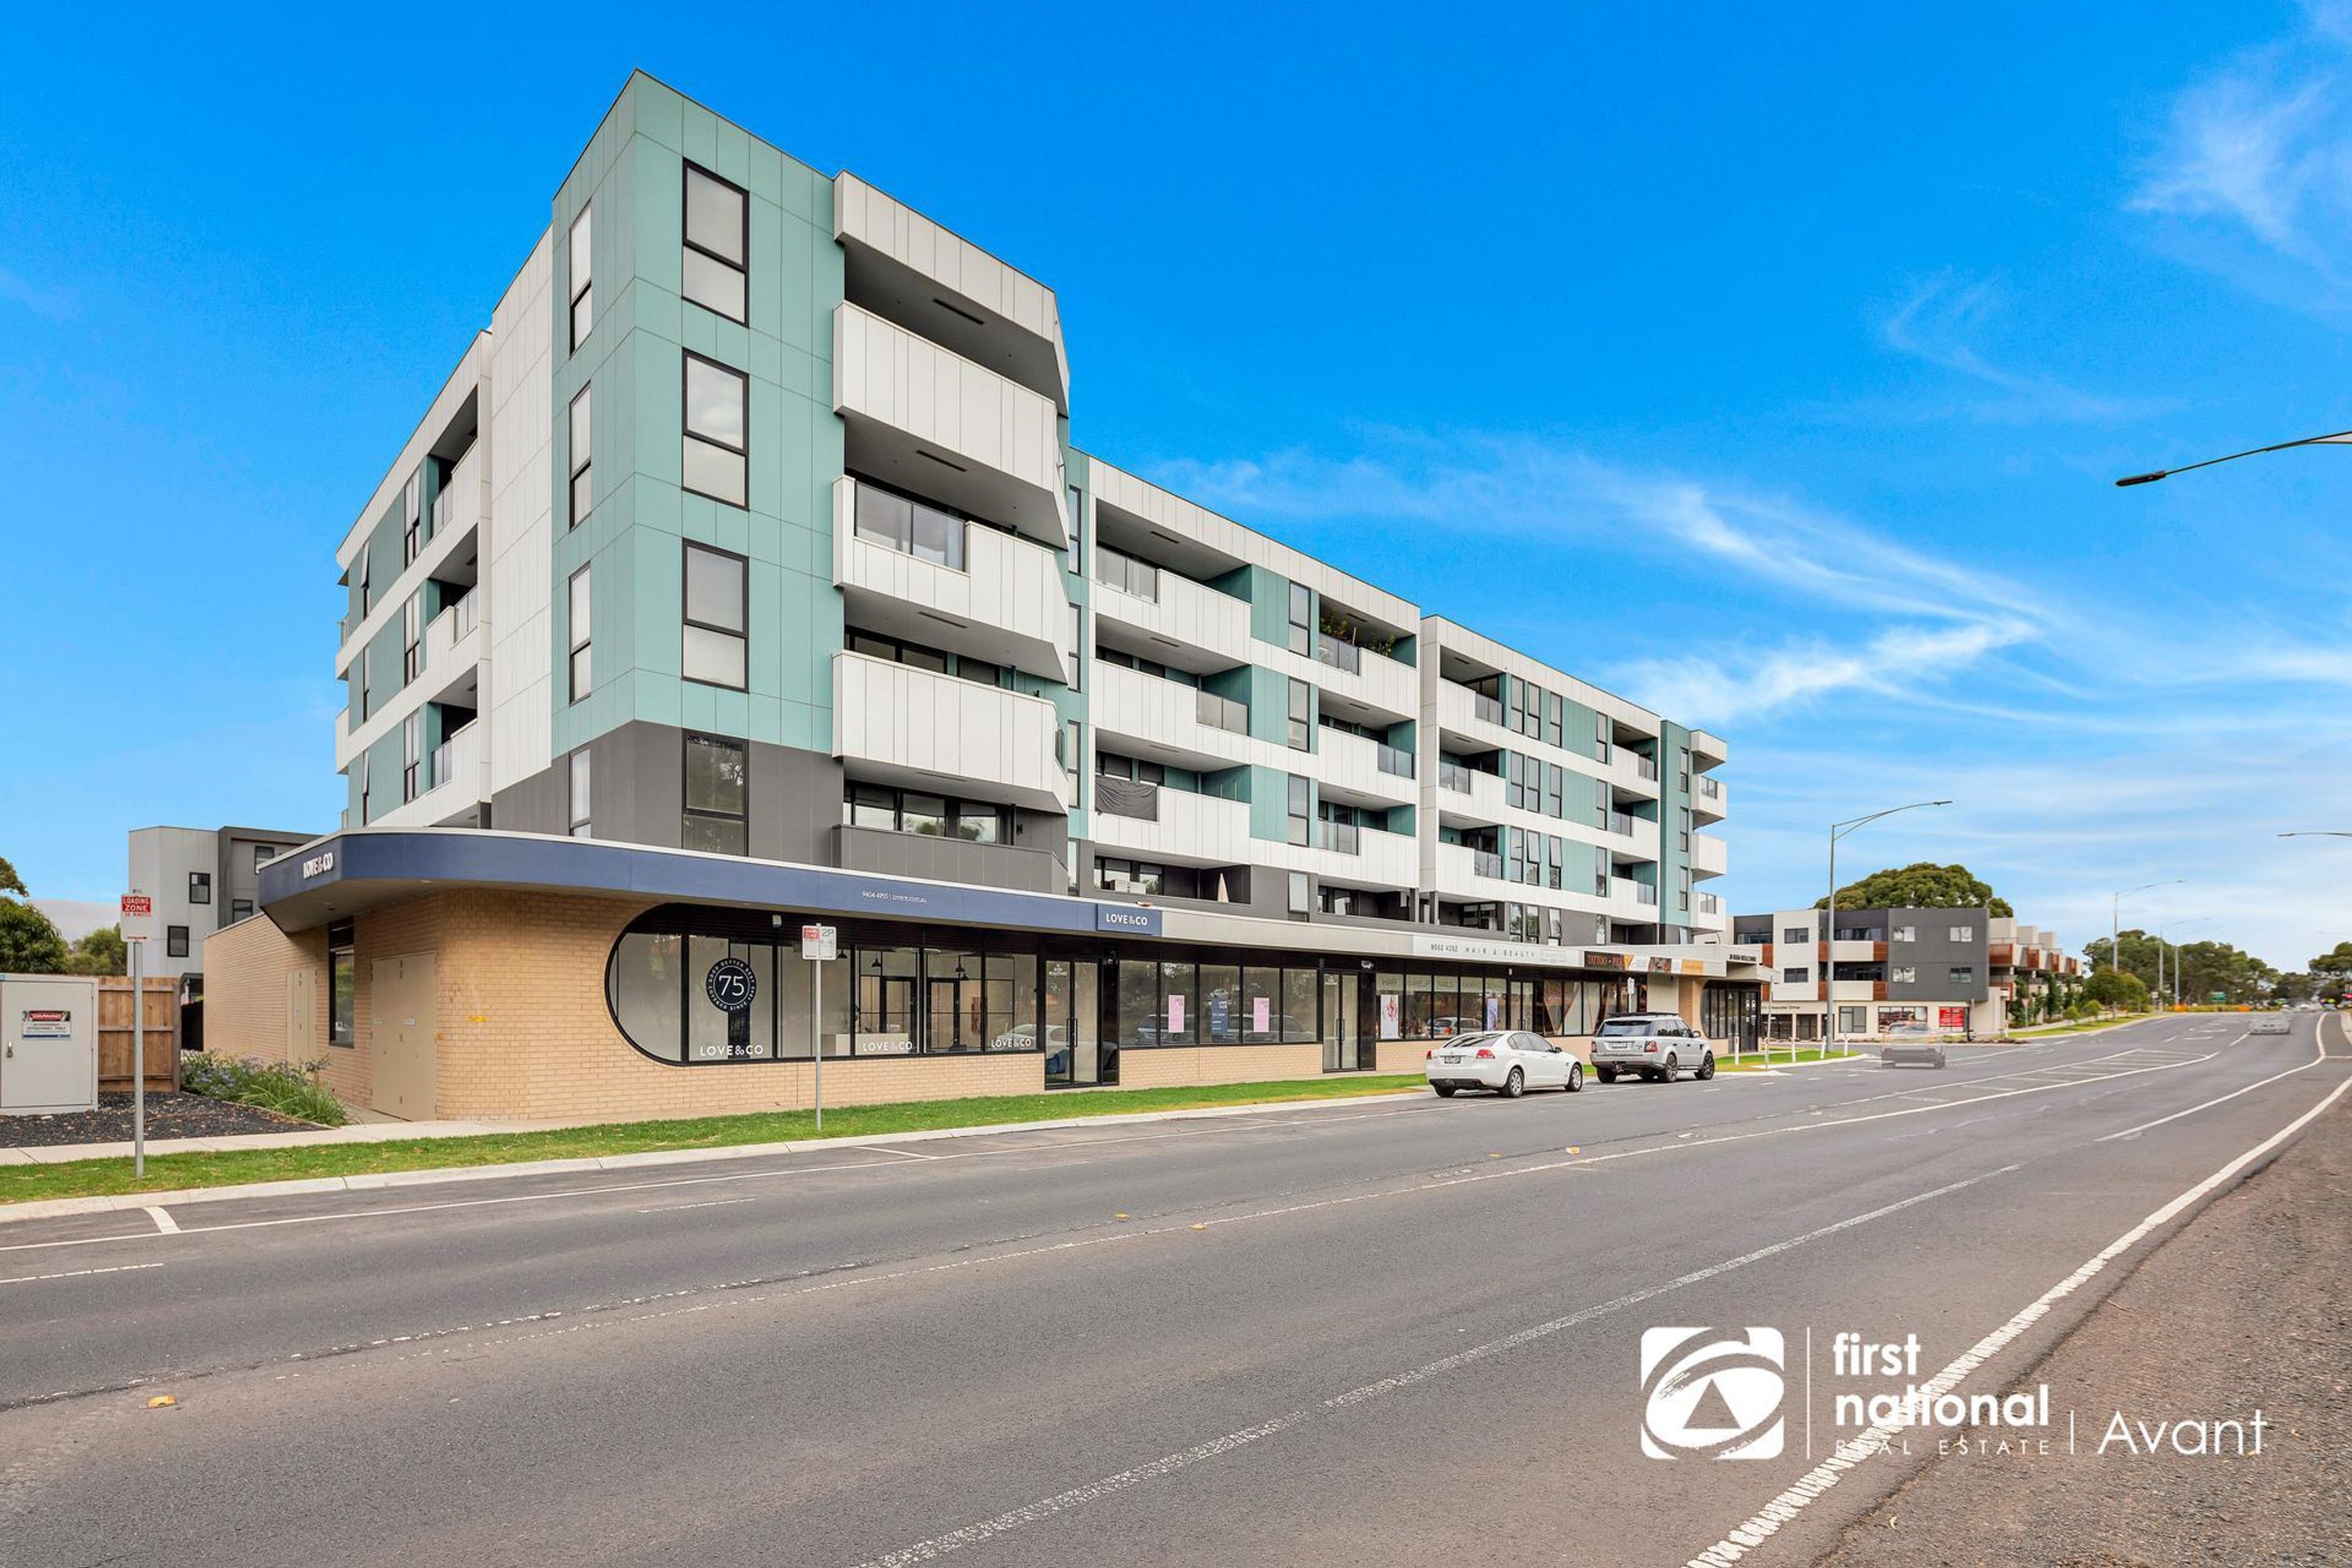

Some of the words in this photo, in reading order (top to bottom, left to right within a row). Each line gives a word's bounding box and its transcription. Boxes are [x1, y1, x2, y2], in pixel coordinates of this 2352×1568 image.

[303, 852, 333, 878] LOVE&CO
[1105, 913, 1148, 925] LOVE&CO
[822, 928, 834, 937] 2P
[719, 975, 745, 996] 75
[862, 1041, 913, 1051] LOVE&CO
[990, 1038, 1032, 1047] LOVE&CO
[700, 1044, 764, 1056] LOVE&CO
